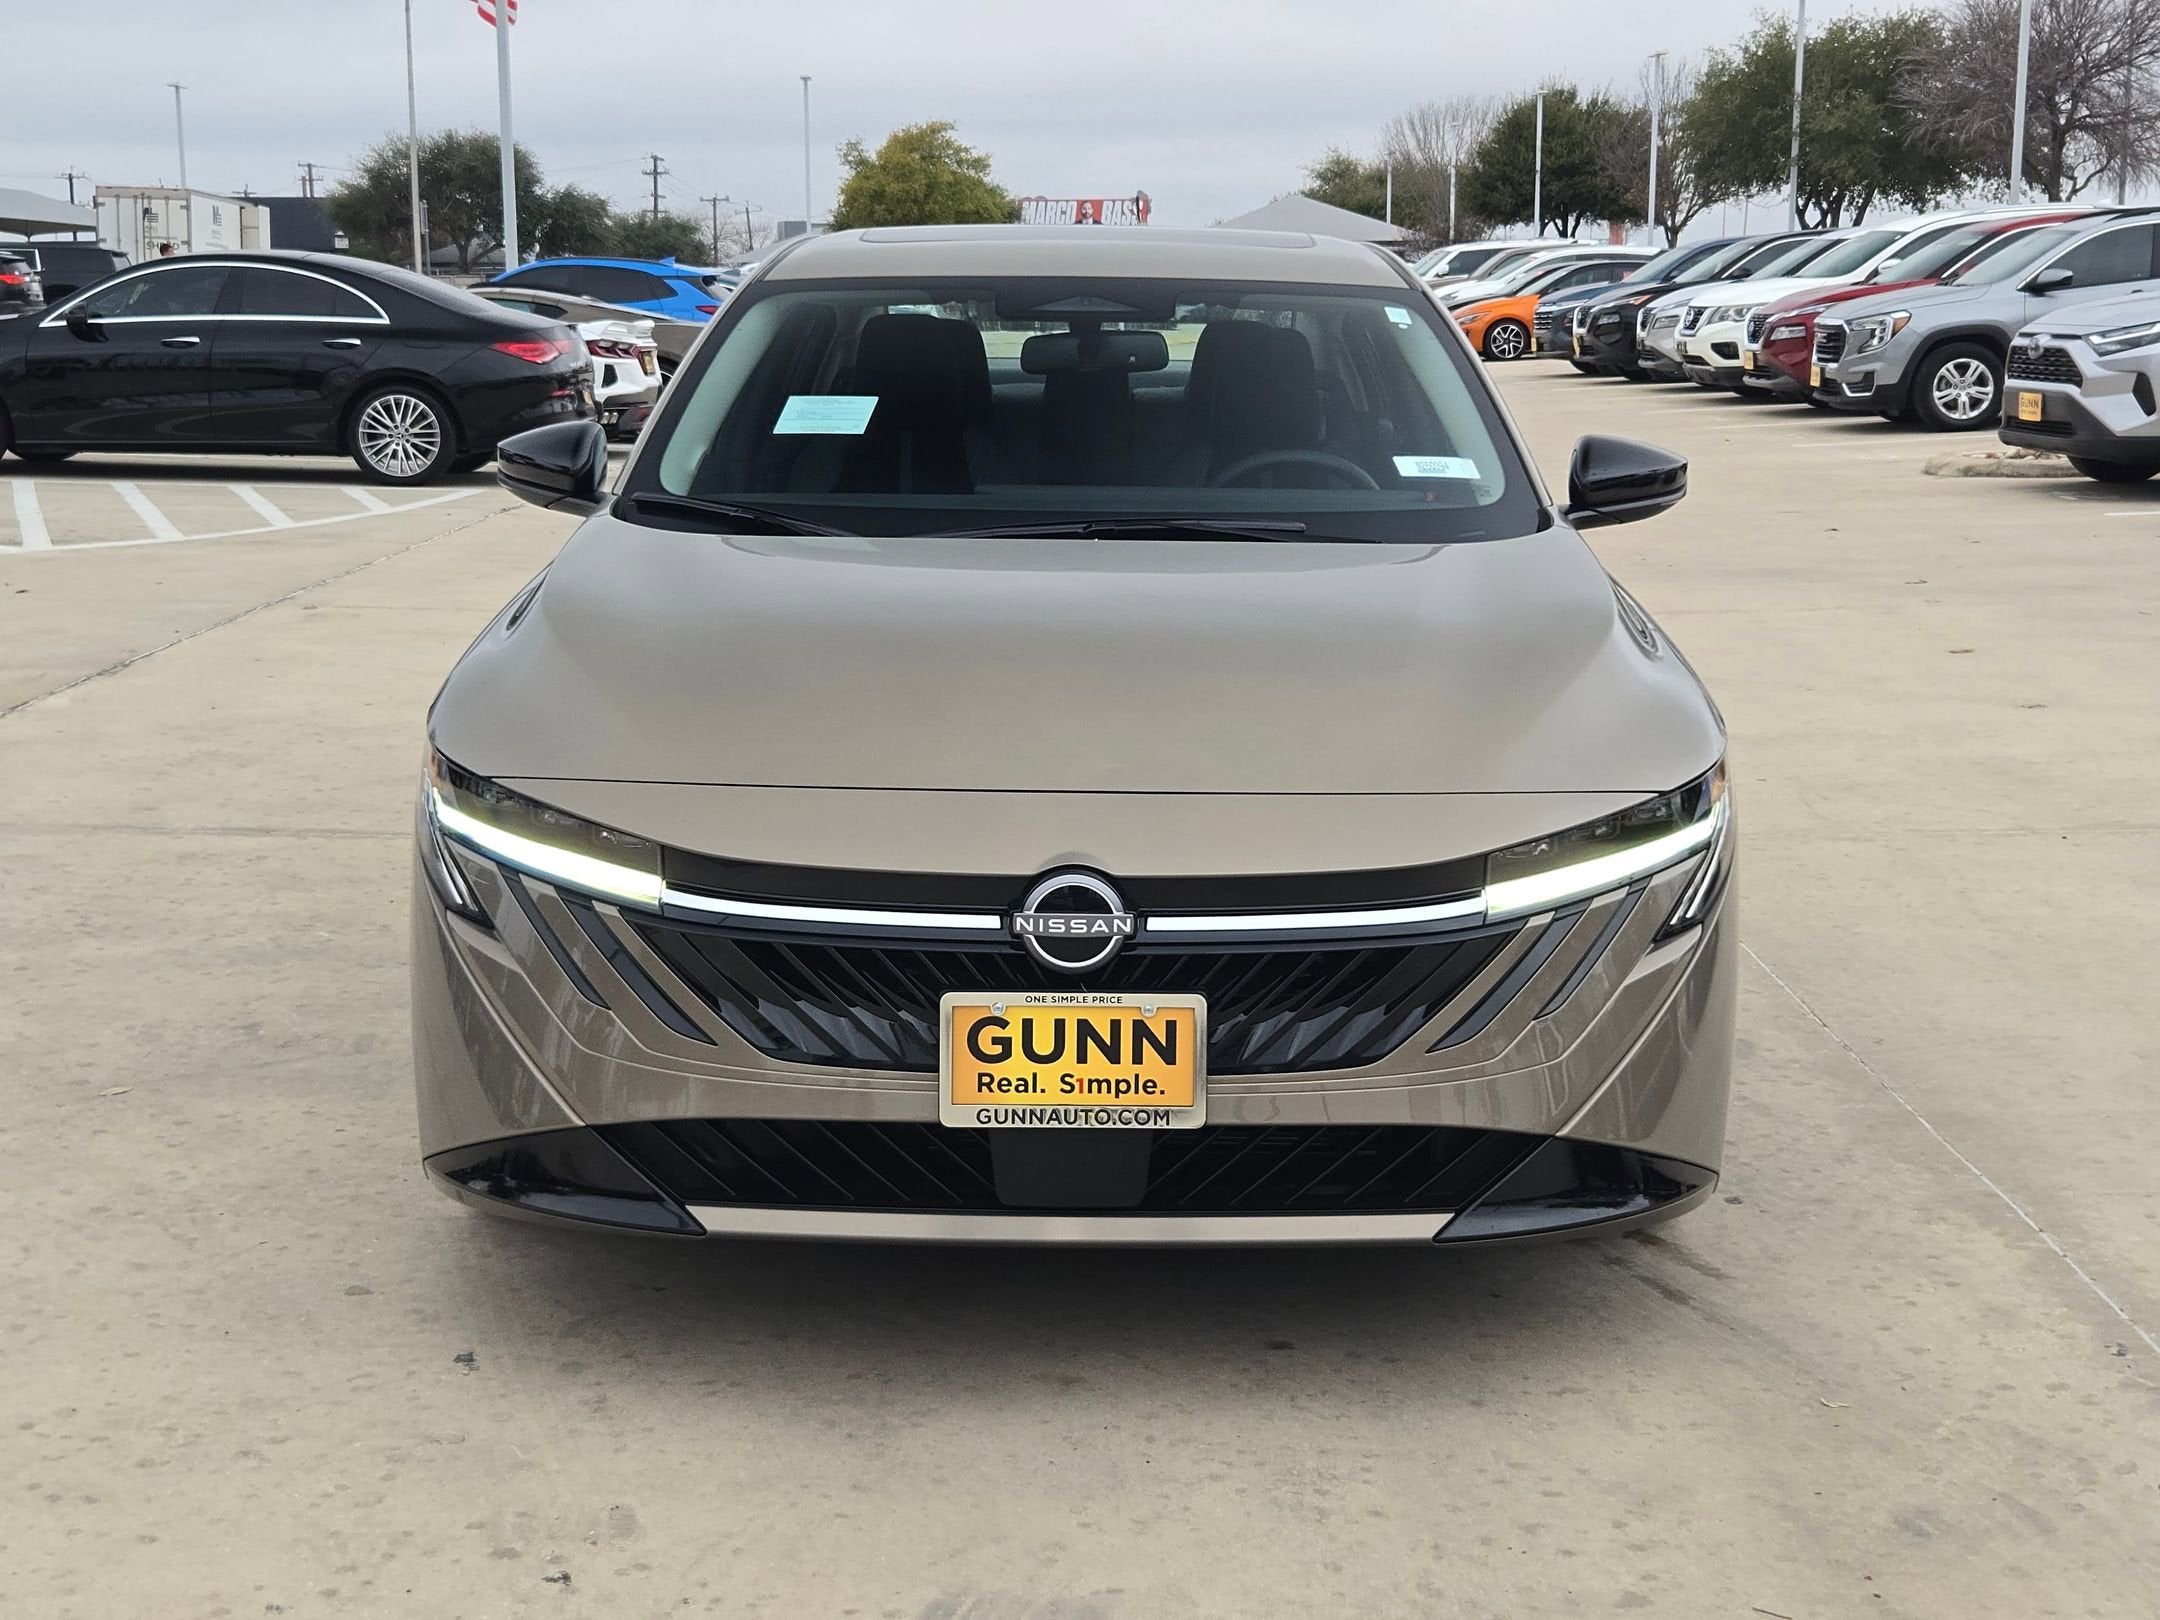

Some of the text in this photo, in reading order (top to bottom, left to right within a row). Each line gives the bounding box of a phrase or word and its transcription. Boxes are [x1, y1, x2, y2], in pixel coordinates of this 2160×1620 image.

[1022, 200, 1077, 225] MARCO
[1016, 917, 1131, 933] NISSAN
[1025, 995, 1123, 1004] ONE SIMPLE PRICE
[966, 1015, 1177, 1066] GUNN
[977, 1072, 1046, 1094] Real.
[976, 1108, 1170, 1126] GUNNAUTO.COM
